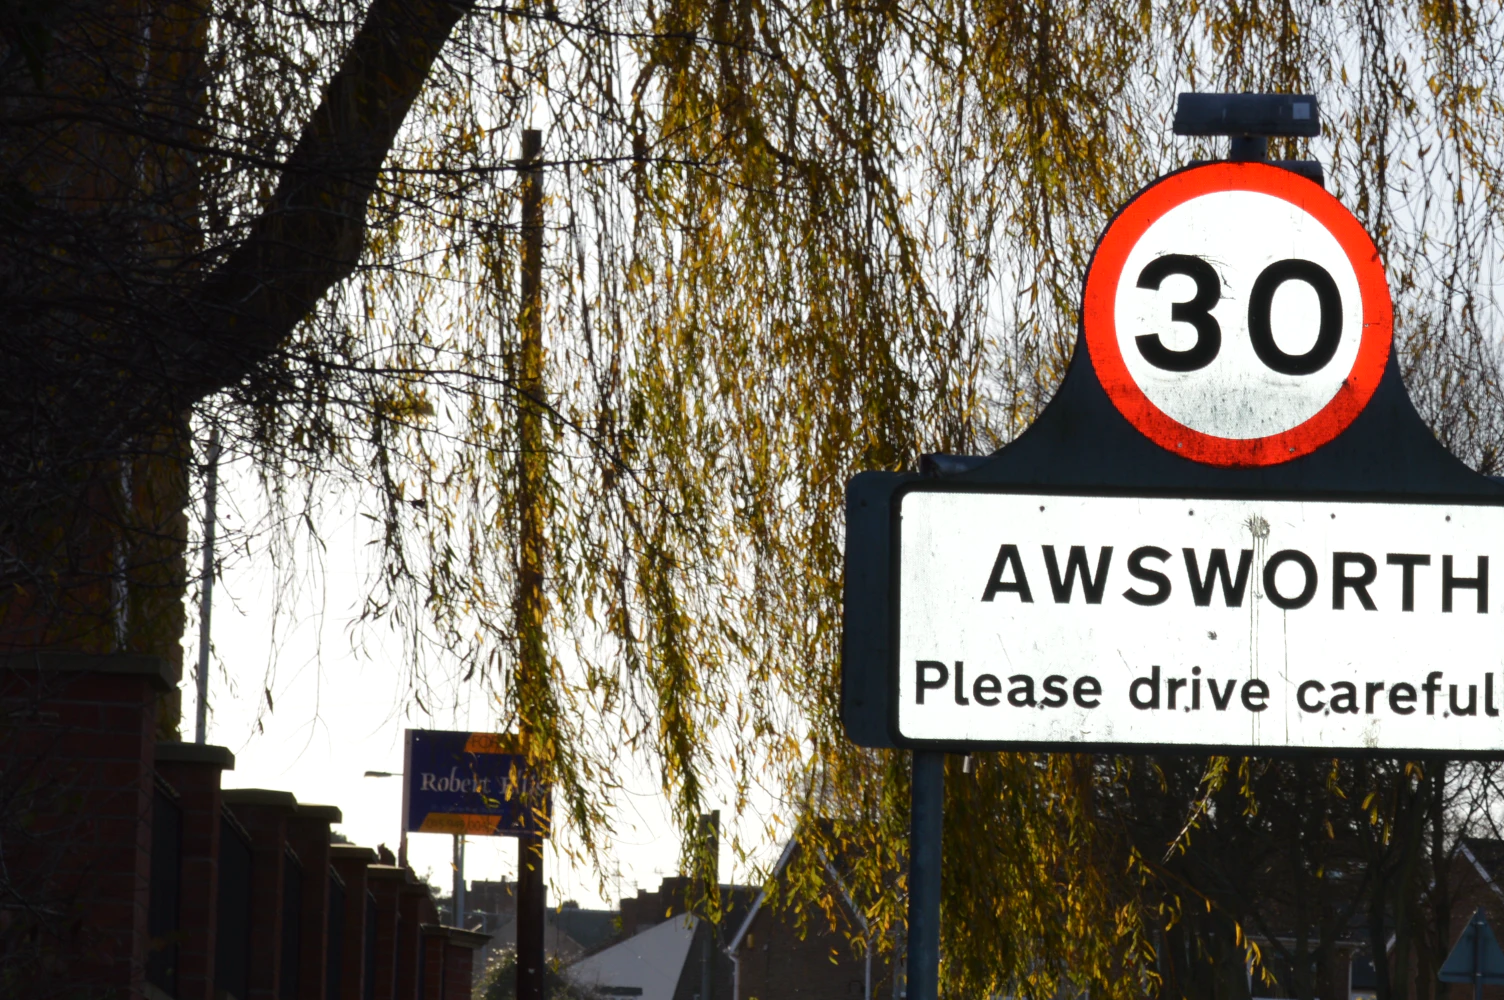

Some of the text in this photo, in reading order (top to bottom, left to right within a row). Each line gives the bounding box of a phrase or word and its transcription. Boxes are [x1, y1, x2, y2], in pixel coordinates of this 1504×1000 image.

[1134, 252, 1344, 376] 30
[980, 543, 1491, 614] AWSWORTH
[914, 659, 1102, 710] Please
[1129, 665, 1269, 713] drive
[420, 766, 491, 794] Robert
